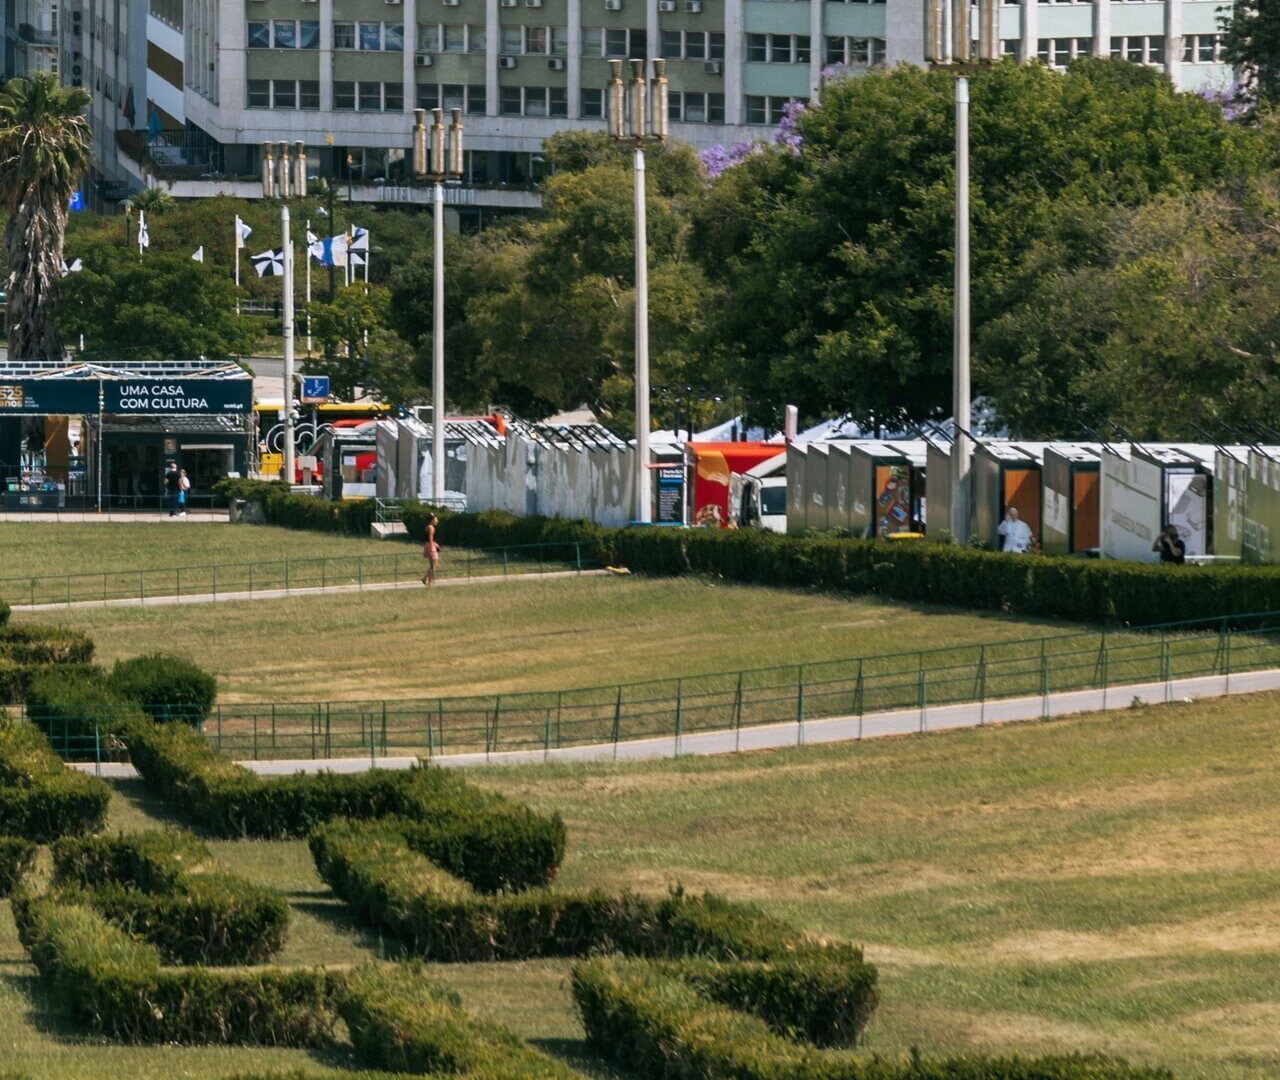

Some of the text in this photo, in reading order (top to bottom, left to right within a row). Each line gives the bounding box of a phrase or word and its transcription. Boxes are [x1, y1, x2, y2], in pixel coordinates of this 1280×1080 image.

[120, 385, 185, 396] UMA CASA
[120, 398, 209, 409] COM CULTURA
